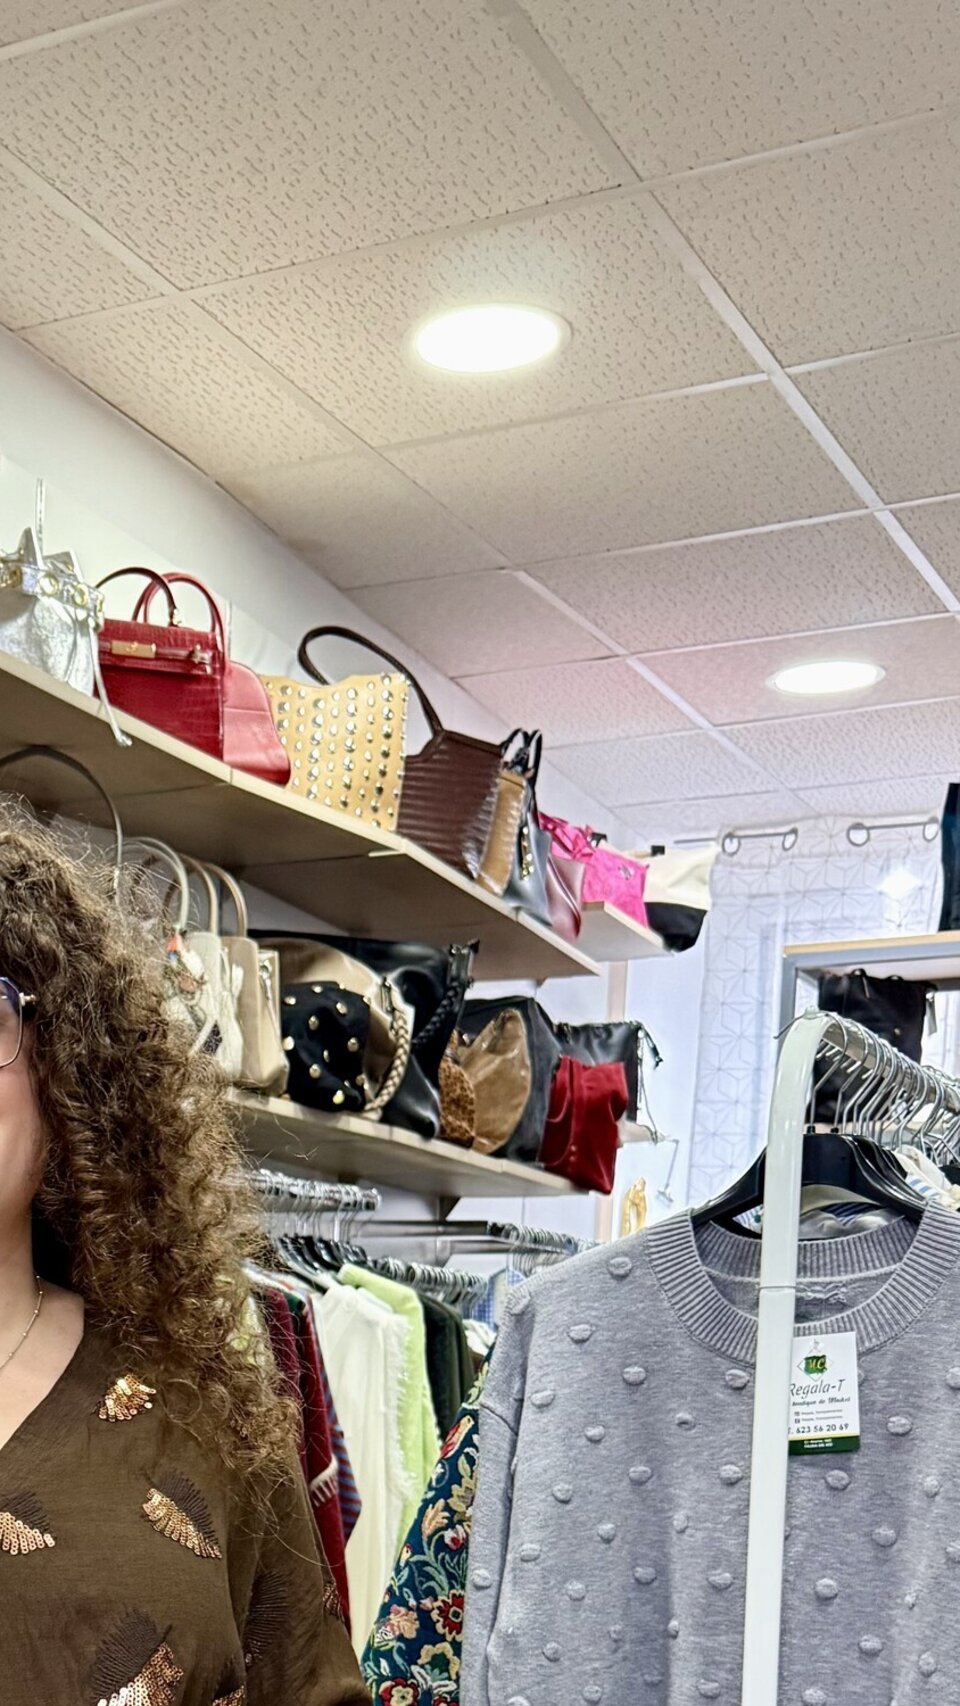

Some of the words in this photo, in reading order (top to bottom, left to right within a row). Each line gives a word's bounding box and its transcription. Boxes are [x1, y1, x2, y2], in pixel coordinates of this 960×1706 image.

[790, 1379, 845, 1399] Regala-T
[796, 1426, 811, 1434] 623
[813, 1425, 824, 1433] 56
[826, 1423, 837, 1432] 20
[839, 1422, 850, 1431] 69
